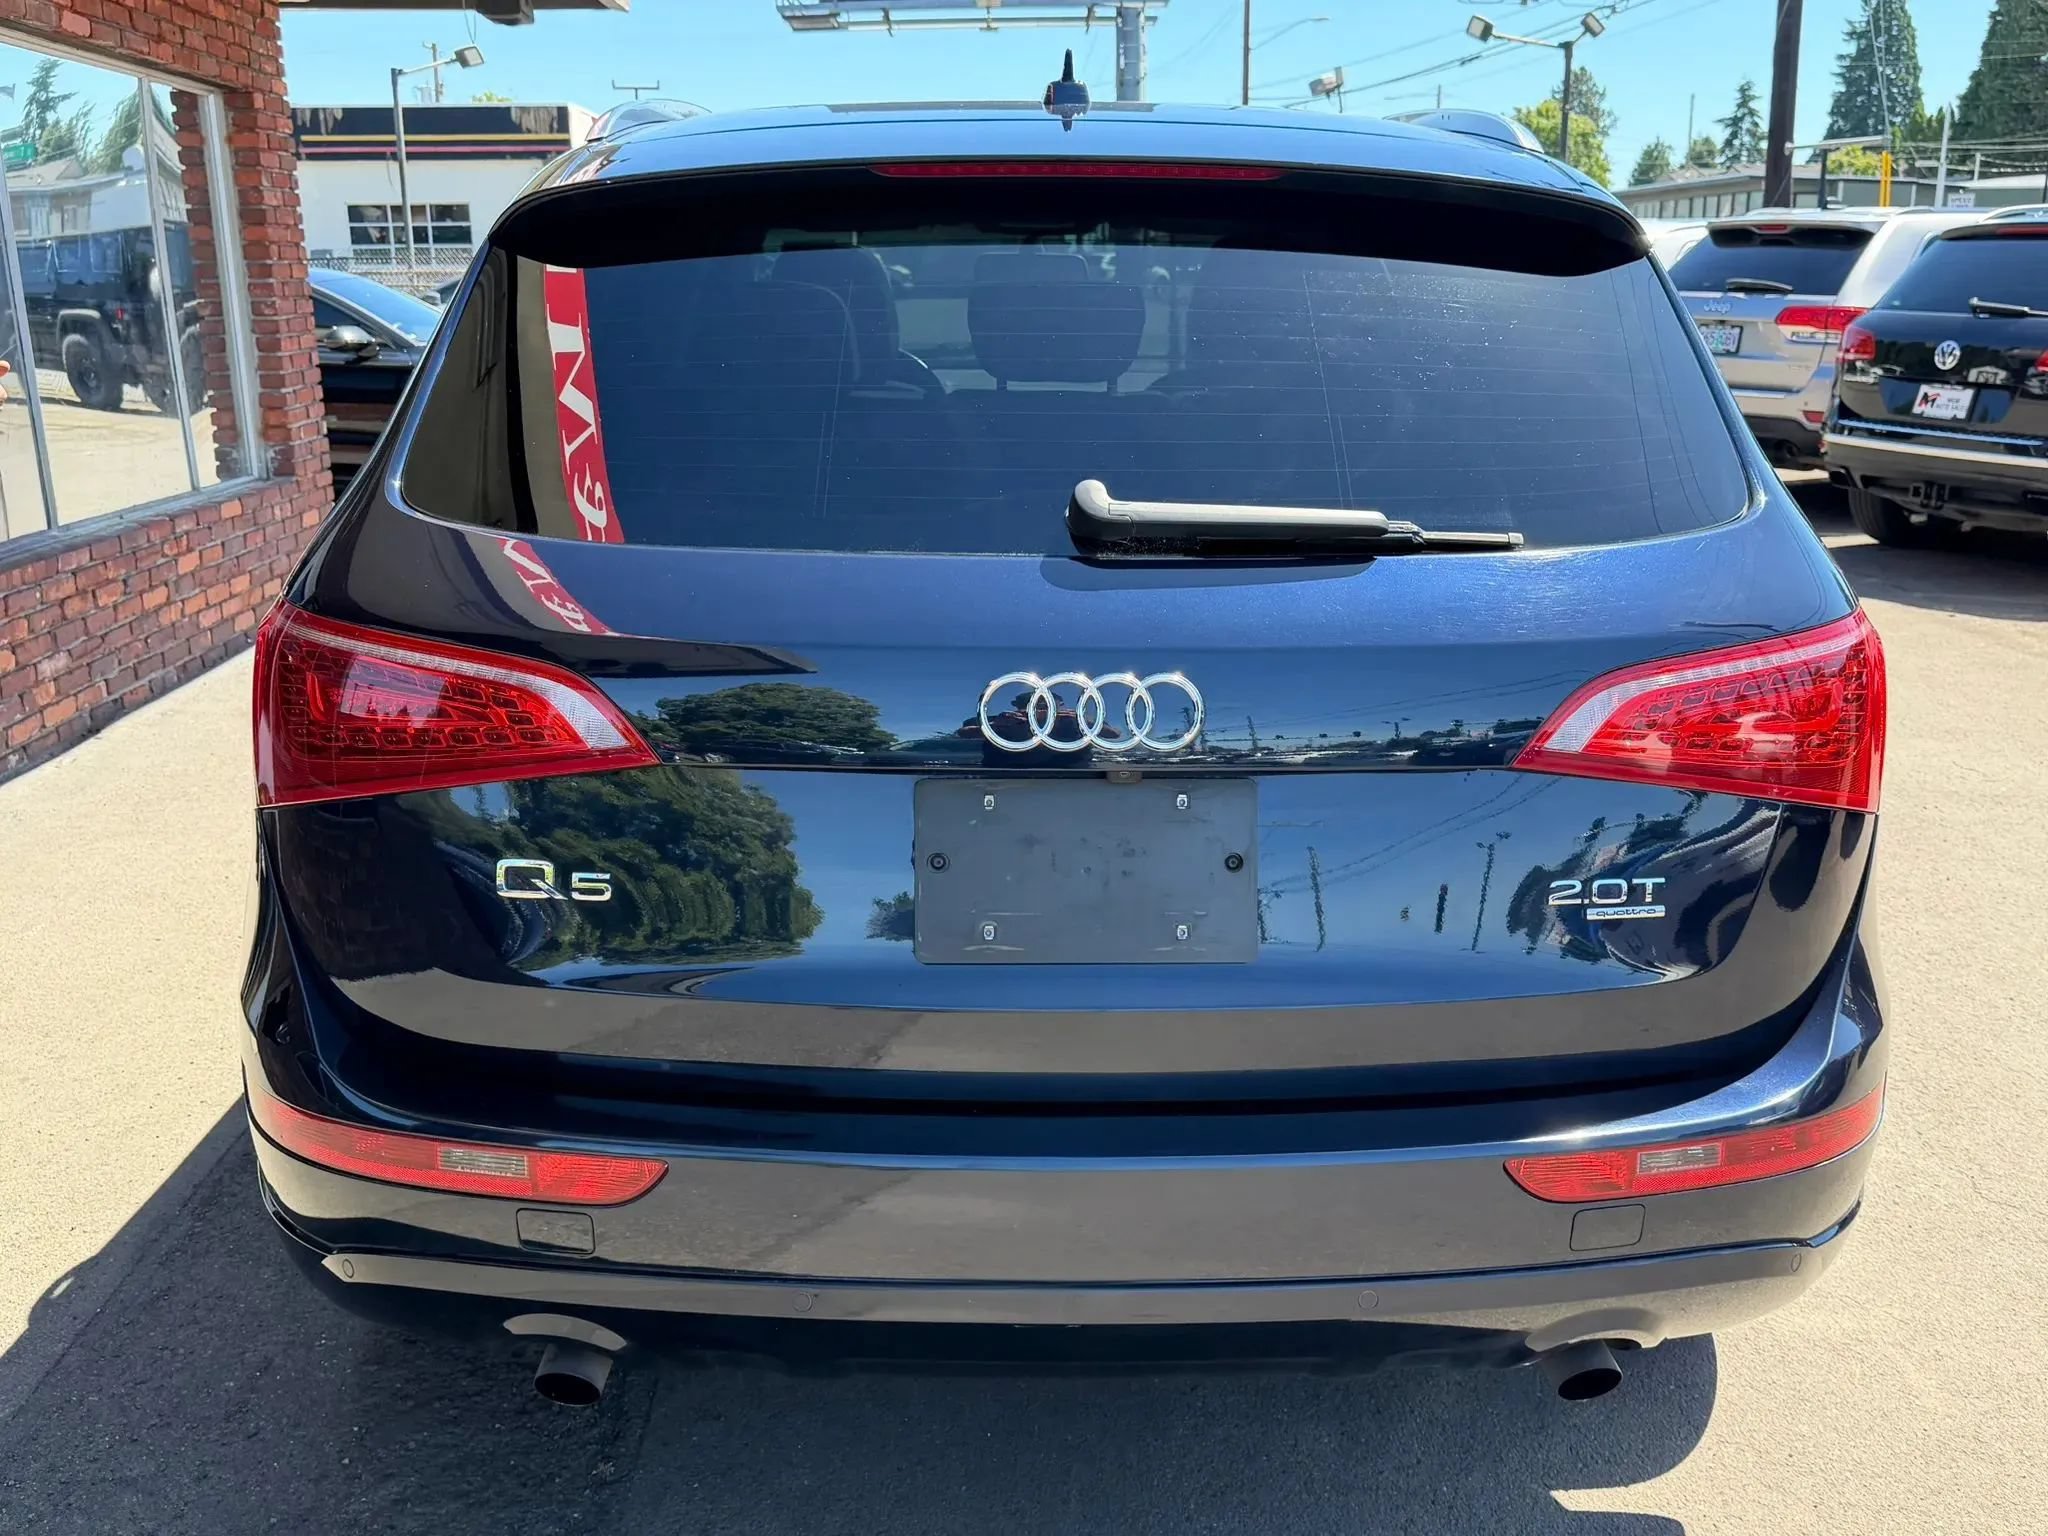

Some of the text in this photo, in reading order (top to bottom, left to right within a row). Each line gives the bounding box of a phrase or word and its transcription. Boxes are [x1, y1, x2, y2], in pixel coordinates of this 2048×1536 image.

[496, 858, 612, 902] Q5
[1548, 877, 1666, 905] 2.0T
[1595, 908, 1657, 917] quattro
